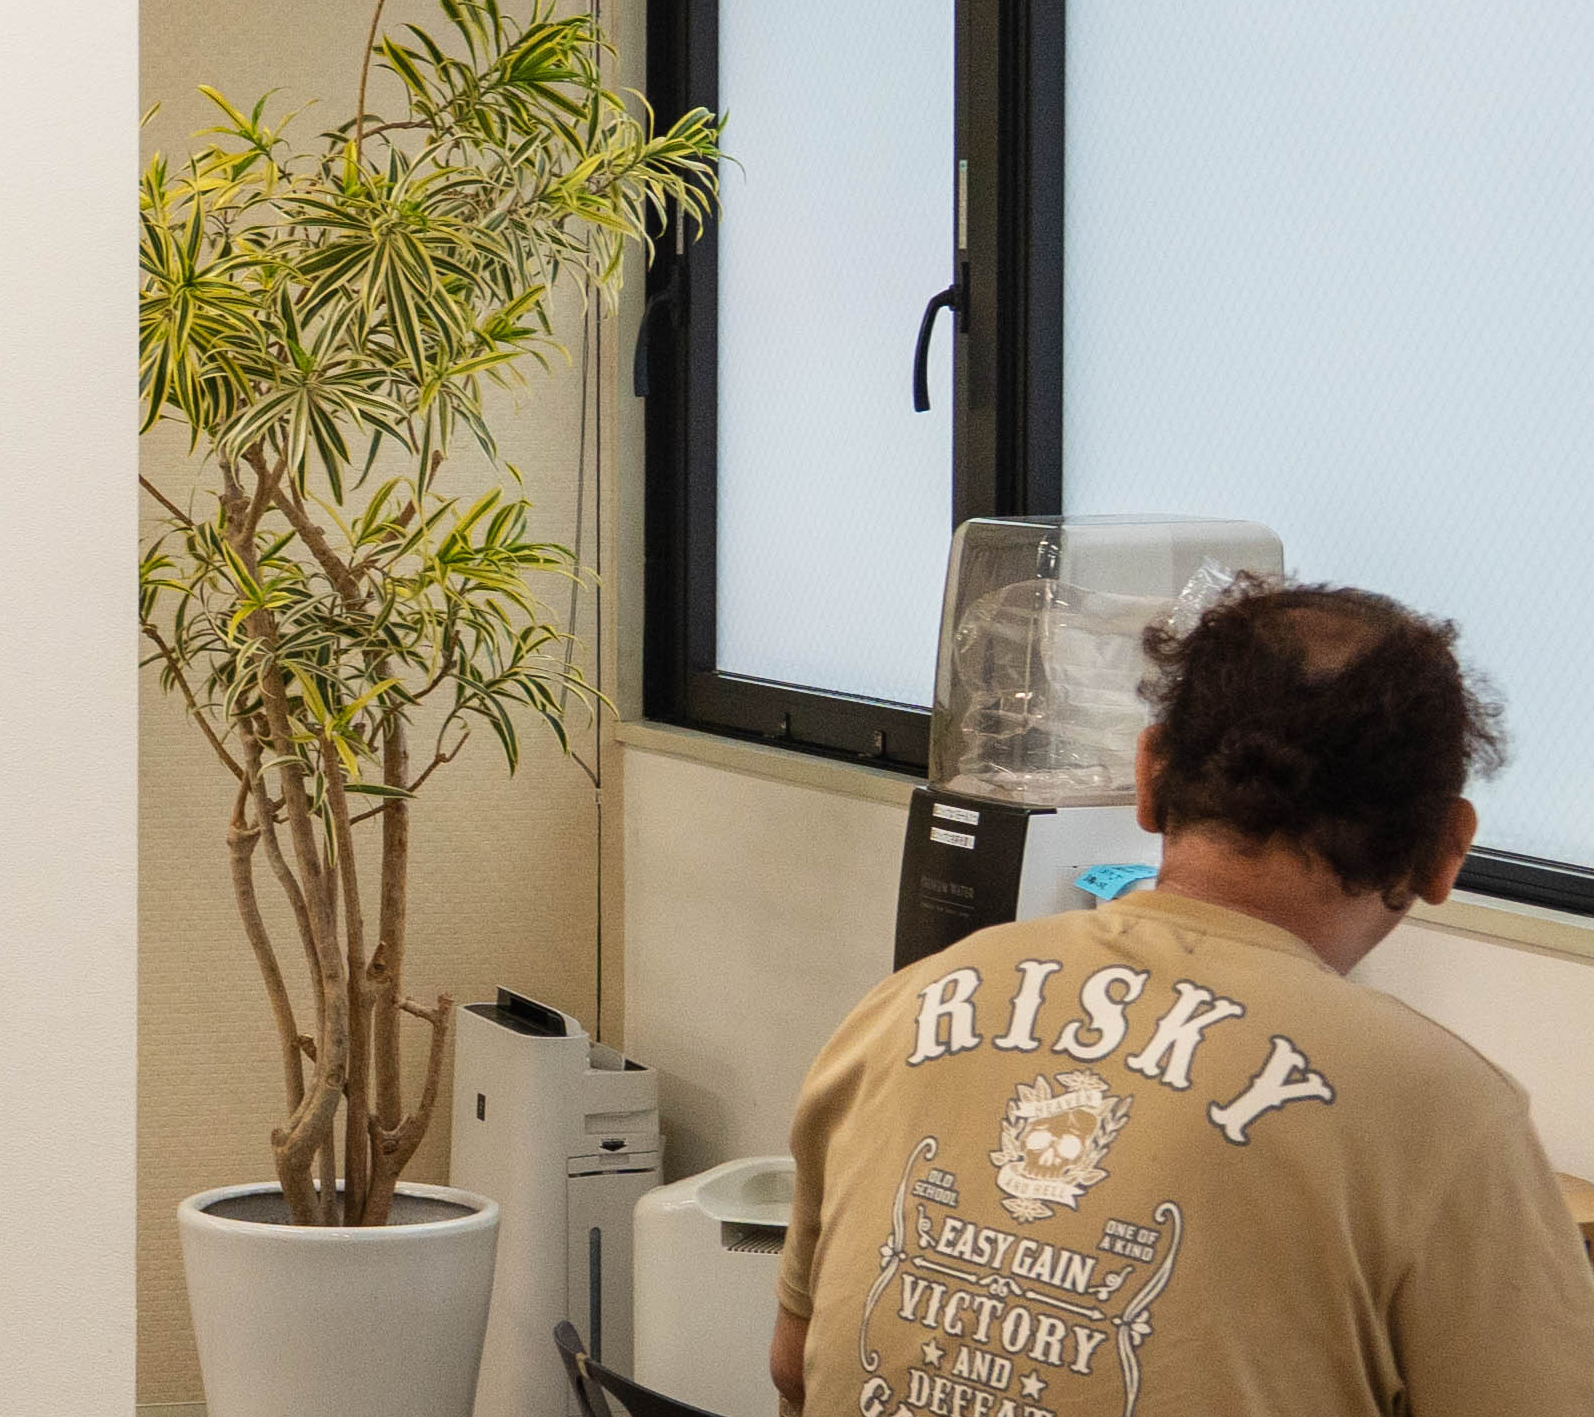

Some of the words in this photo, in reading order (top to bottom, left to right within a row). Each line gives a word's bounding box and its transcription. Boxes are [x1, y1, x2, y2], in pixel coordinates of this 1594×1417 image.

[907, 959, 1333, 1144] RISKY
[912, 1181, 958, 1207] SCHOOL
[928, 1169, 954, 1188] OLD
[1099, 1235, 1111, 1250] A
[1113, 1238, 1154, 1262] KIND
[1105, 1219, 1138, 1240] ONE
[1137, 1228, 1160, 1245] OF
[936, 1216, 1016, 1270] EASY
[1011, 1238, 1096, 1294] GAIN
[899, 1274, 1106, 1374] VICTORY
[951, 1345, 1012, 1390] AND
